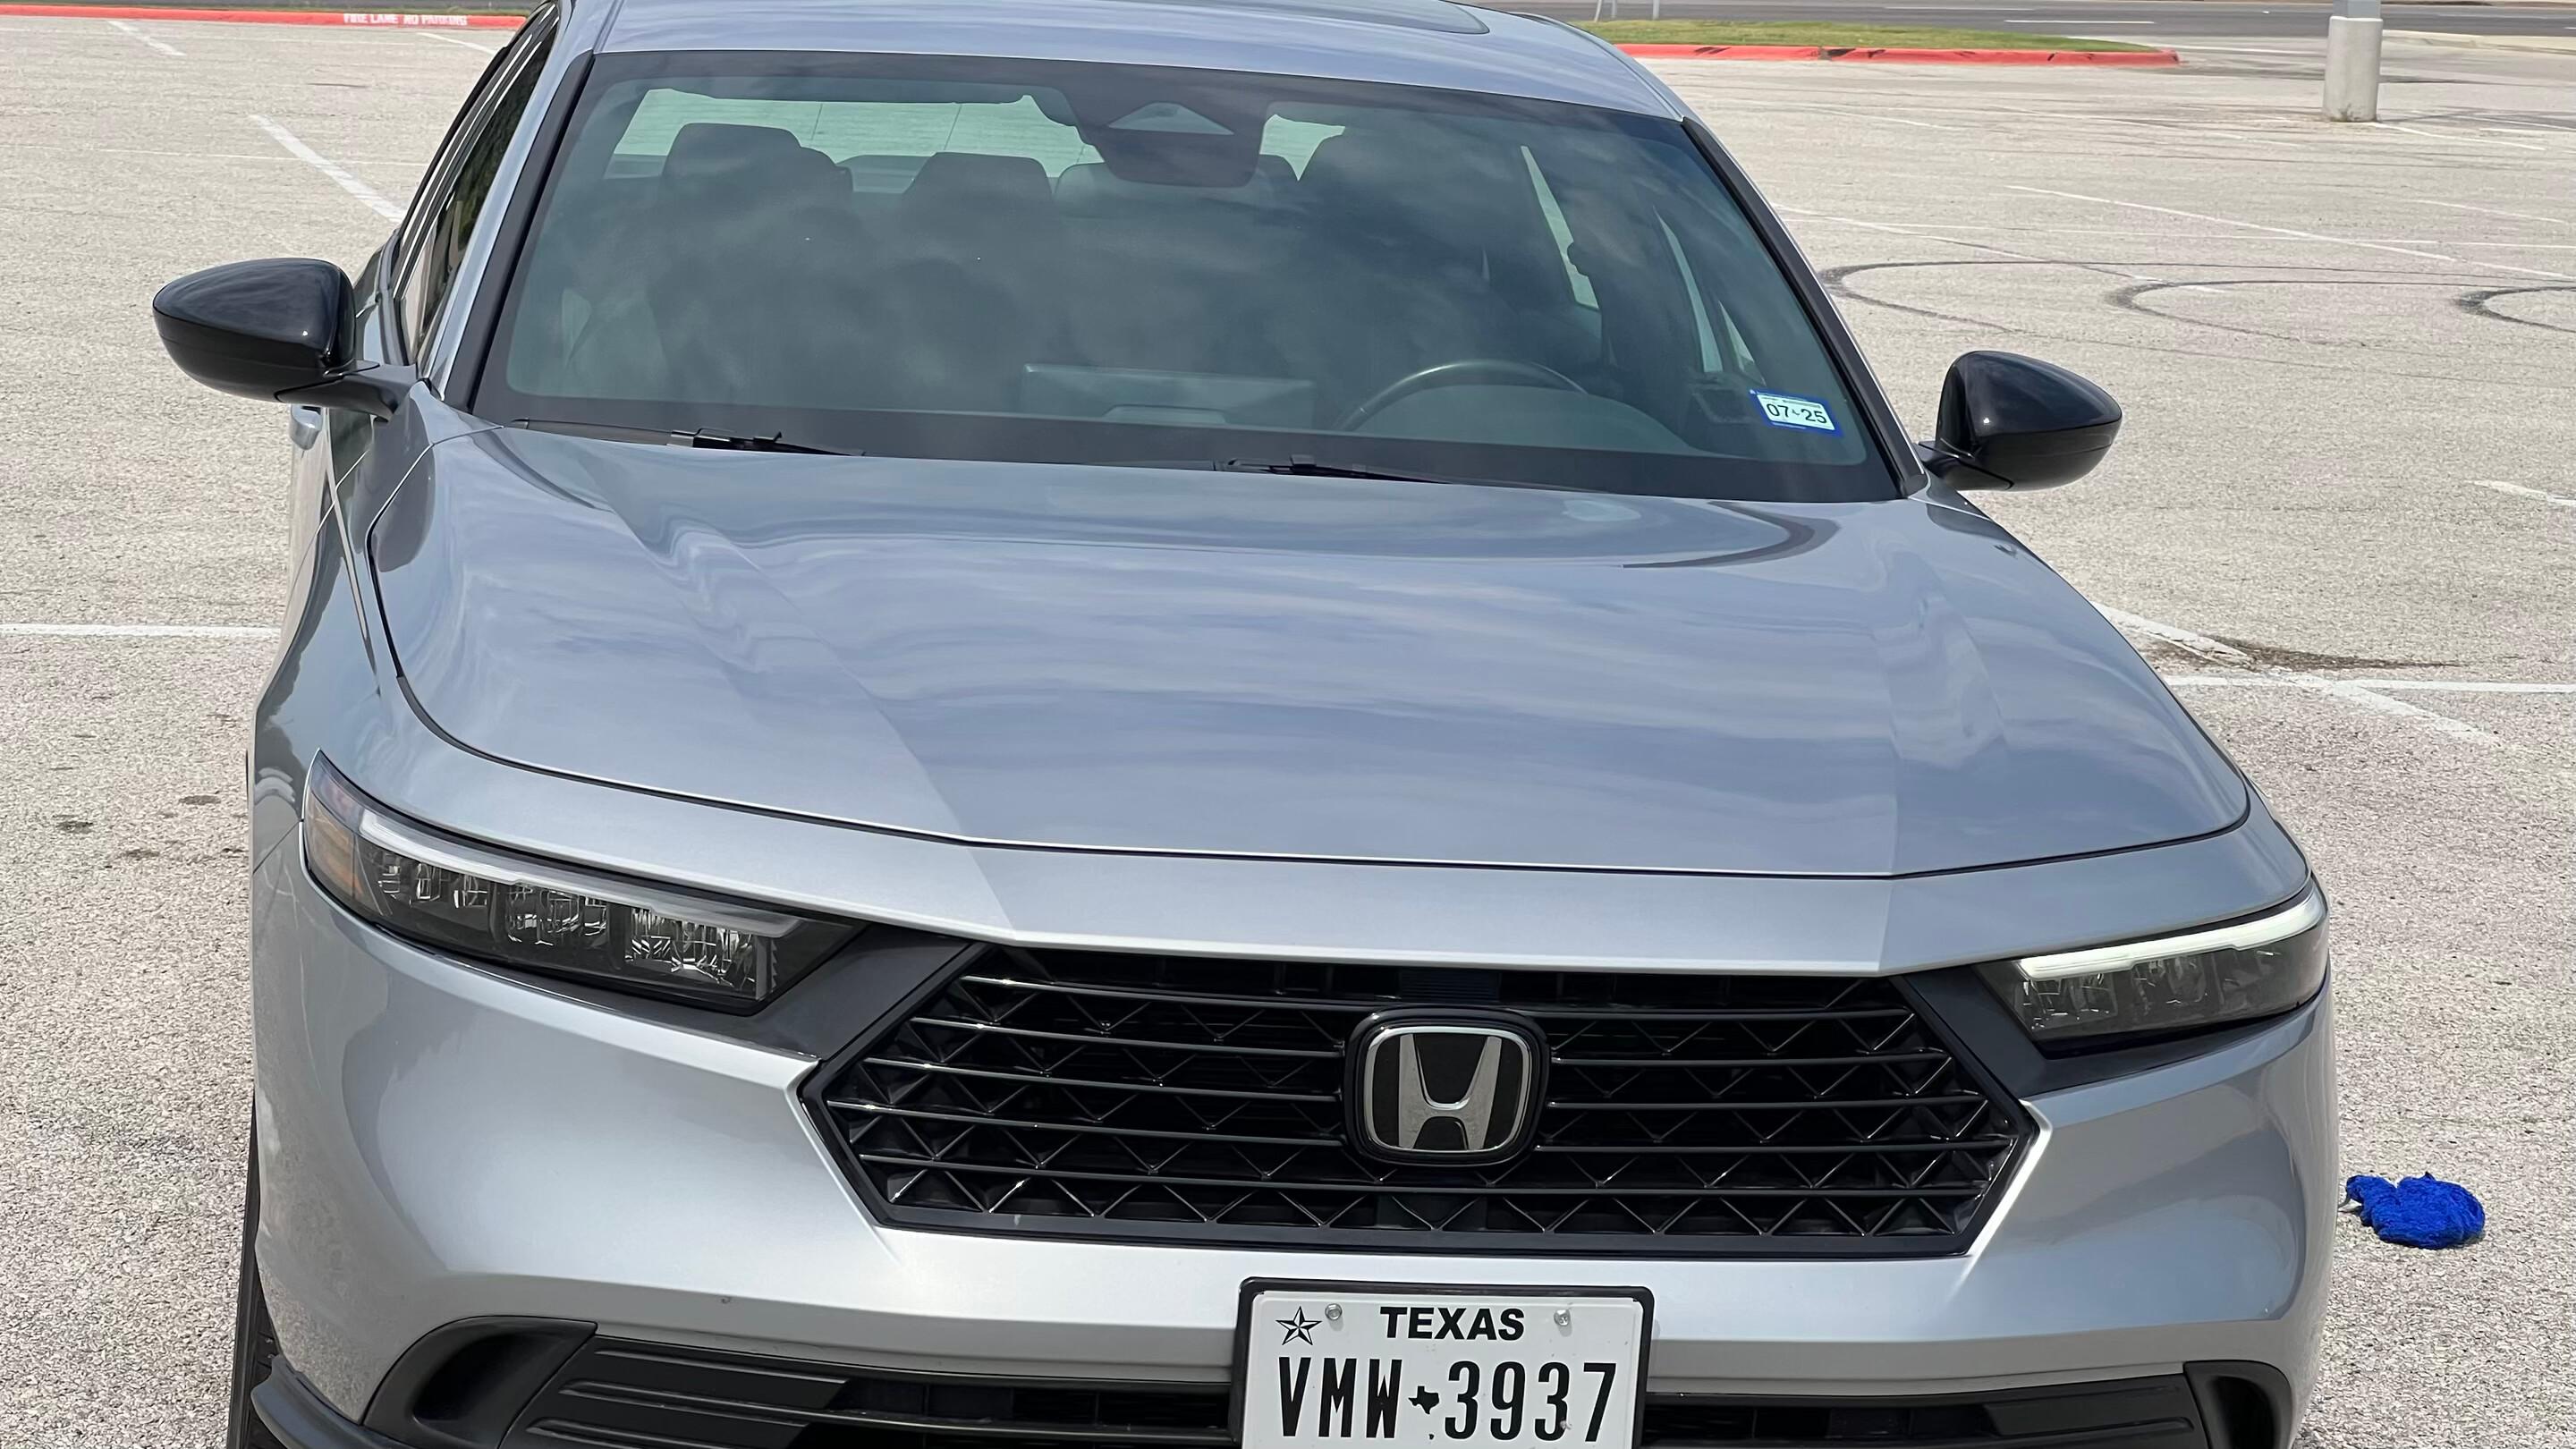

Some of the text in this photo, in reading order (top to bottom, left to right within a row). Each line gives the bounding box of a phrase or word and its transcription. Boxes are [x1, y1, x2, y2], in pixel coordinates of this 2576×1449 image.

[1766, 403, 1789, 418] 07
[1801, 408, 1827, 424] 25
[1379, 1306, 1525, 1341] TEXAS
